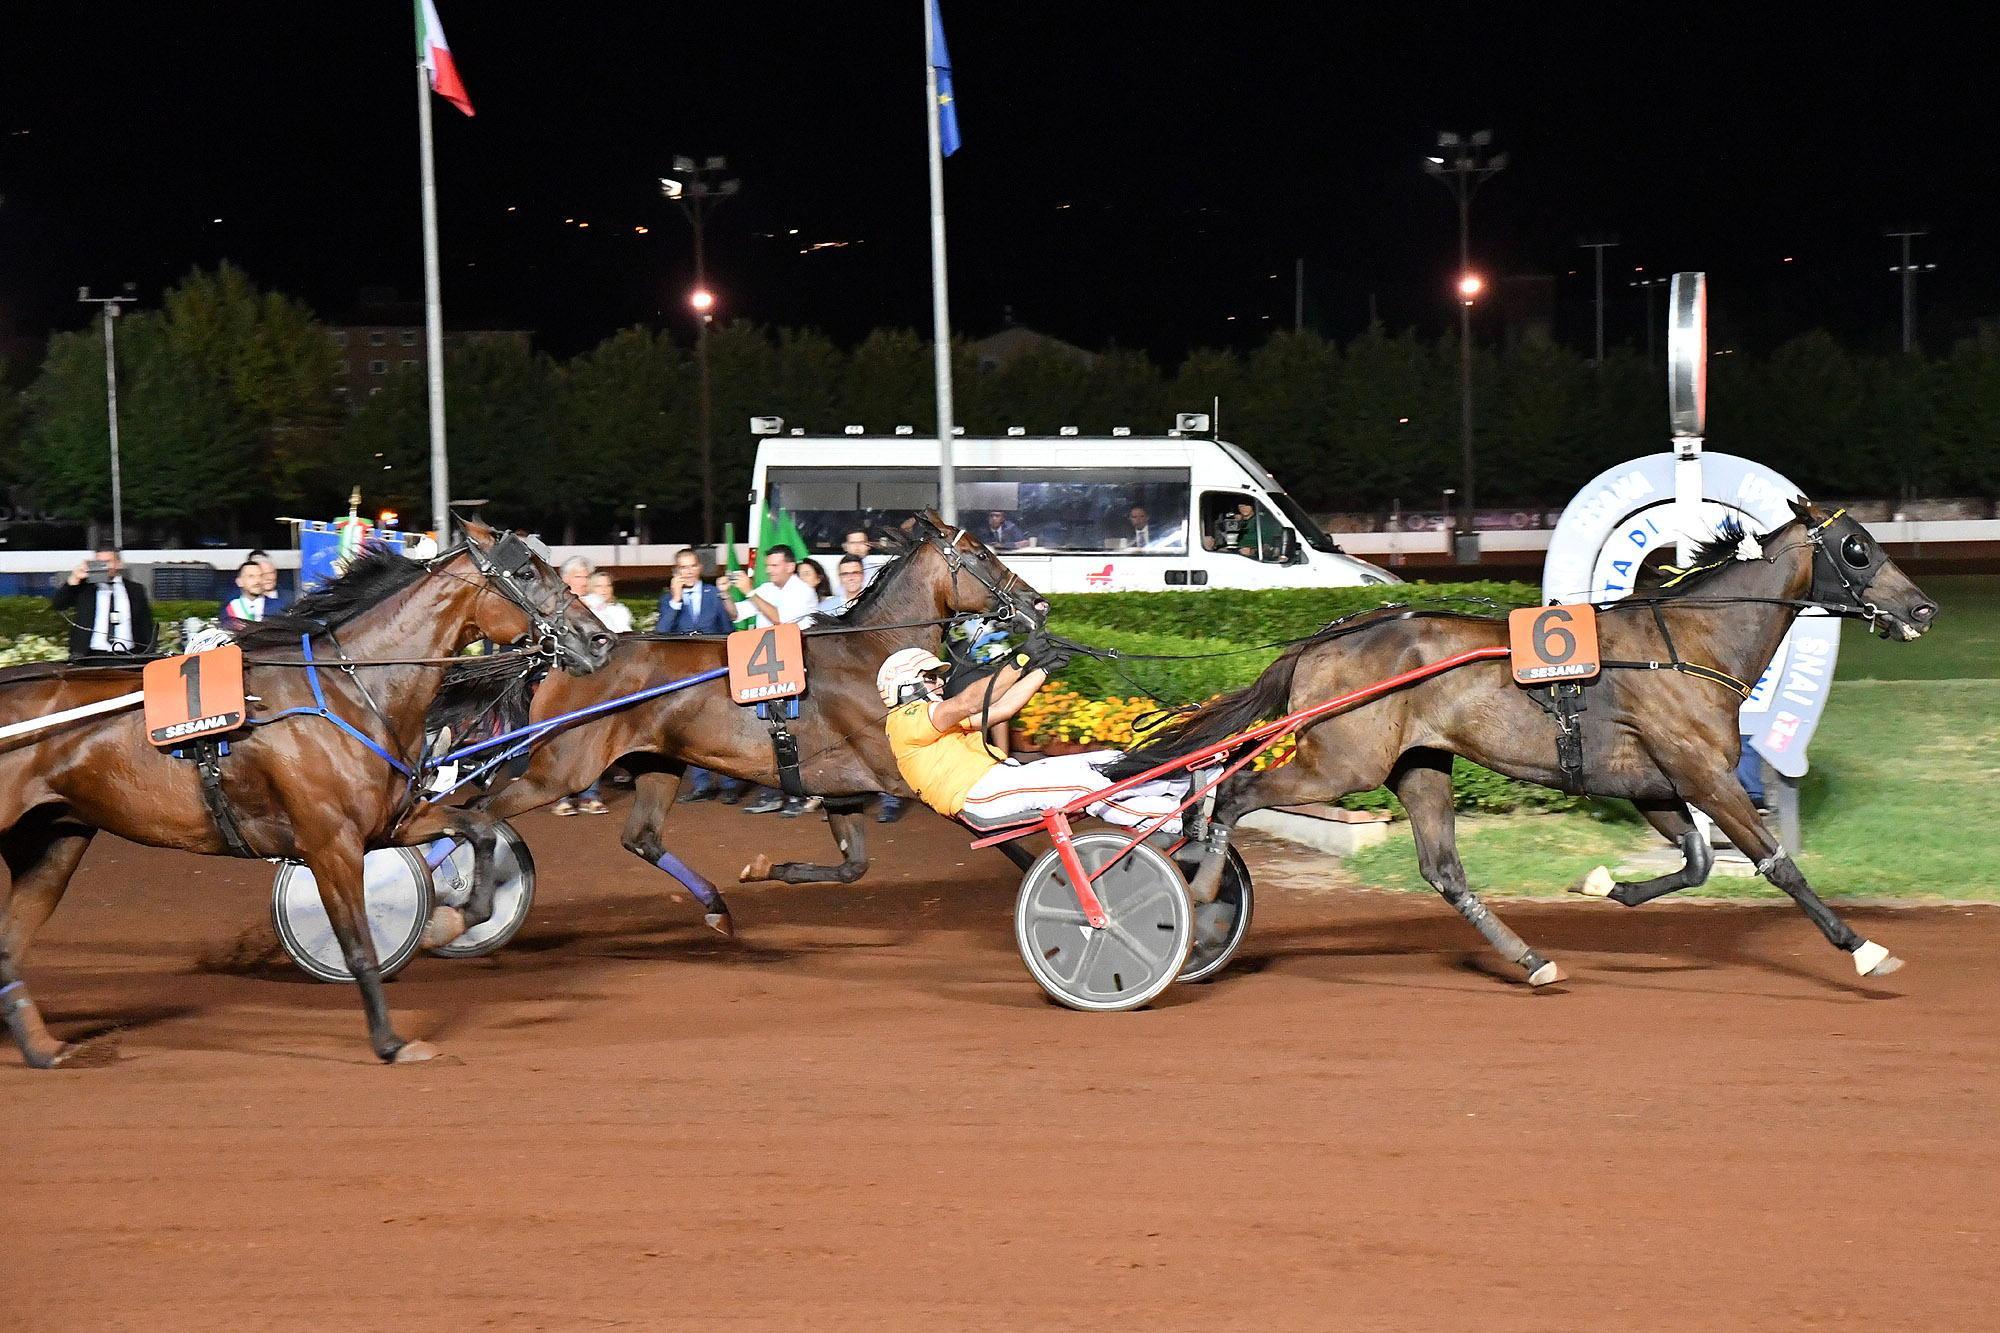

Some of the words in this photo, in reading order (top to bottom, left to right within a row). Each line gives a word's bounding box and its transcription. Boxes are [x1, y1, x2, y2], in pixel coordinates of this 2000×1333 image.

[1604, 560, 1633, 604] TA
[1628, 518, 1660, 549] DI
[747, 629, 785, 684] 4
[1533, 609, 1576, 664] 6
[180, 655, 202, 720] 1
[740, 682, 797, 700] SESANA
[1530, 664, 1585, 678] SESANA
[1782, 637, 1830, 706] SNAI
[165, 715, 228, 738] SESANA
